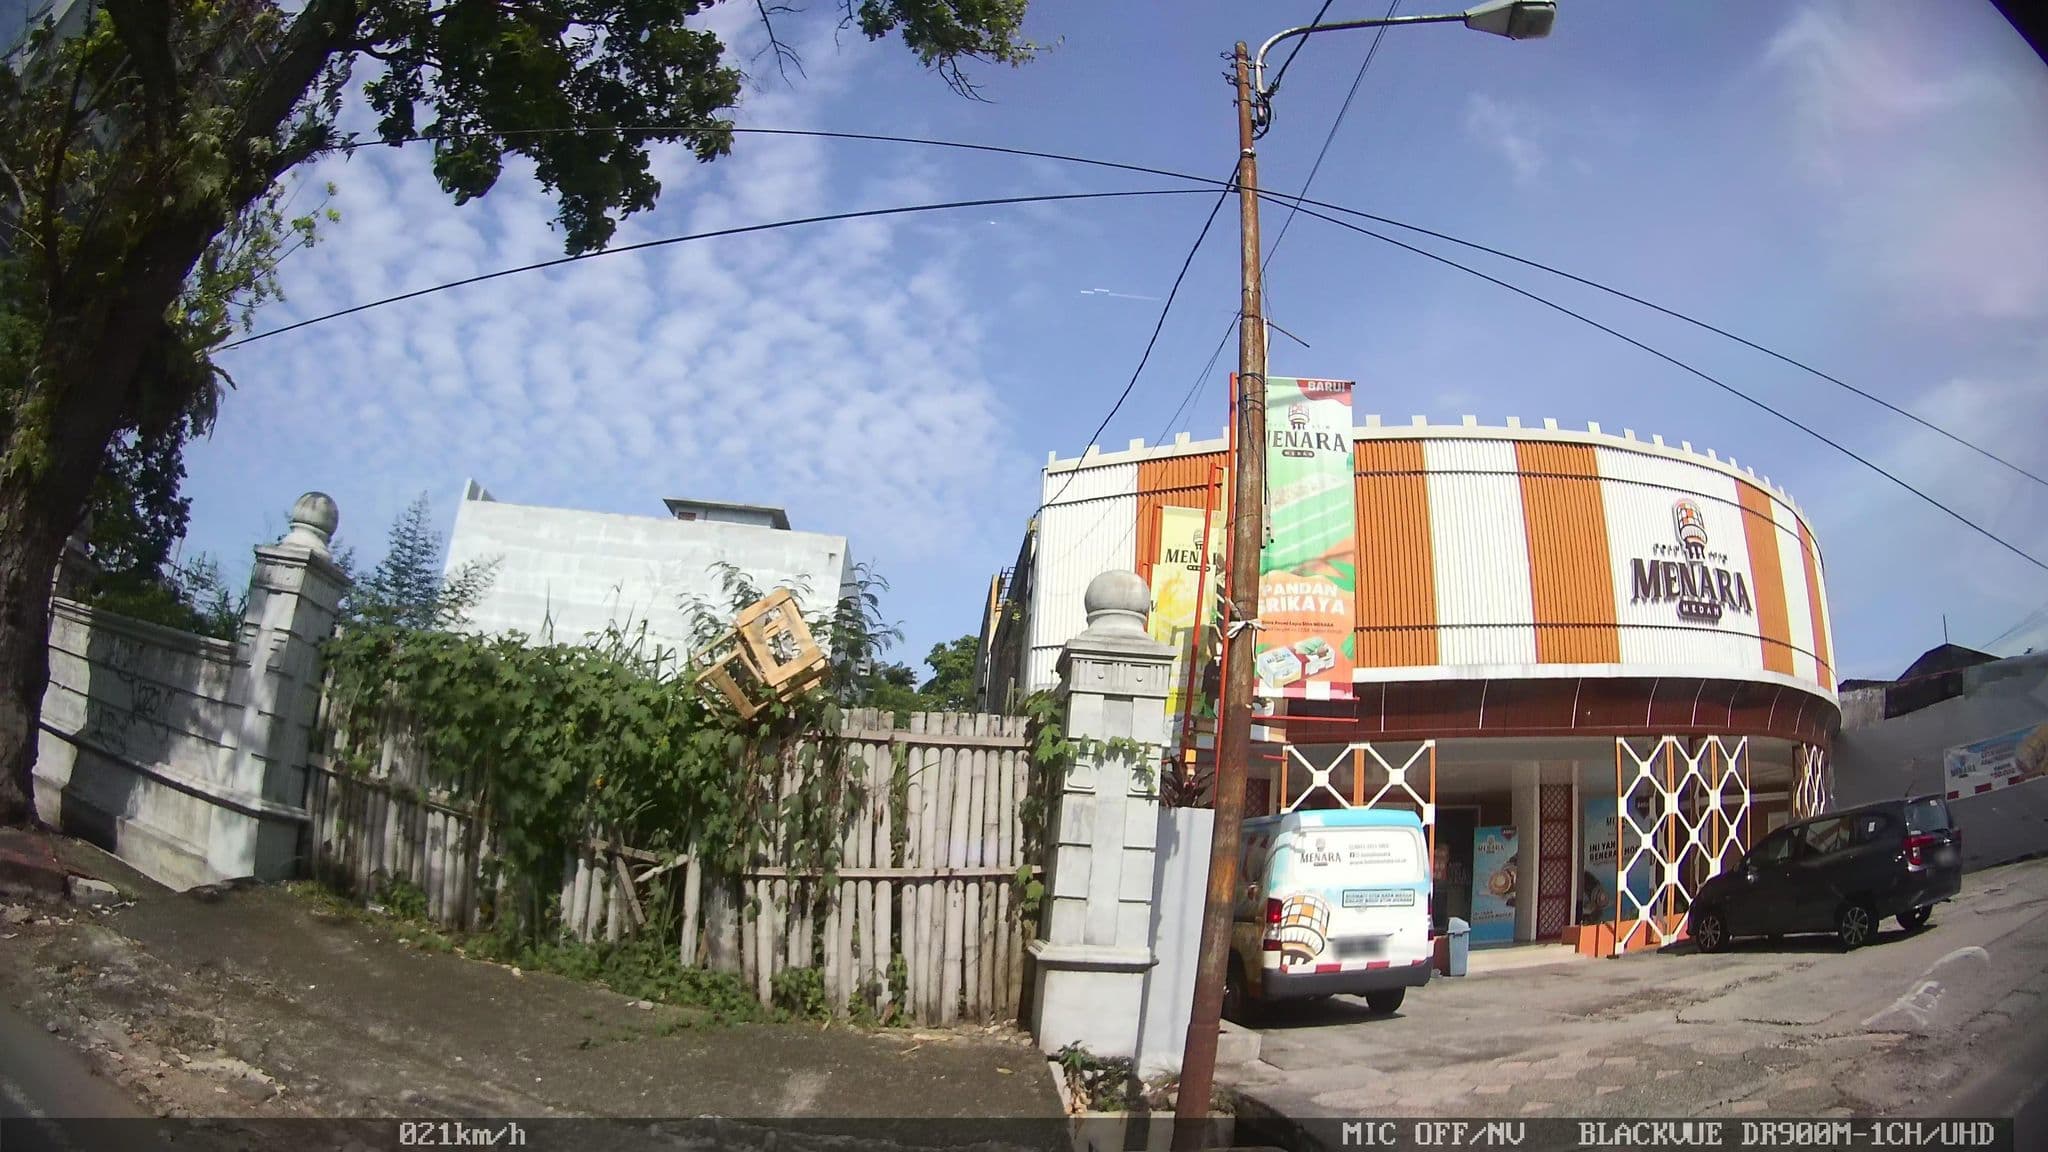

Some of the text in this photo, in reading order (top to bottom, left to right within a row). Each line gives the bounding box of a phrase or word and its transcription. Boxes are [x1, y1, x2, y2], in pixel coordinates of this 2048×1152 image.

[1267, 430, 1348, 453] ENARA
[1263, 582, 1339, 597] PANDAN
[1630, 557, 1752, 615] MENARA
[1682, 603, 1721, 617] MEDAN
[1300, 852, 1342, 863] MENARA
